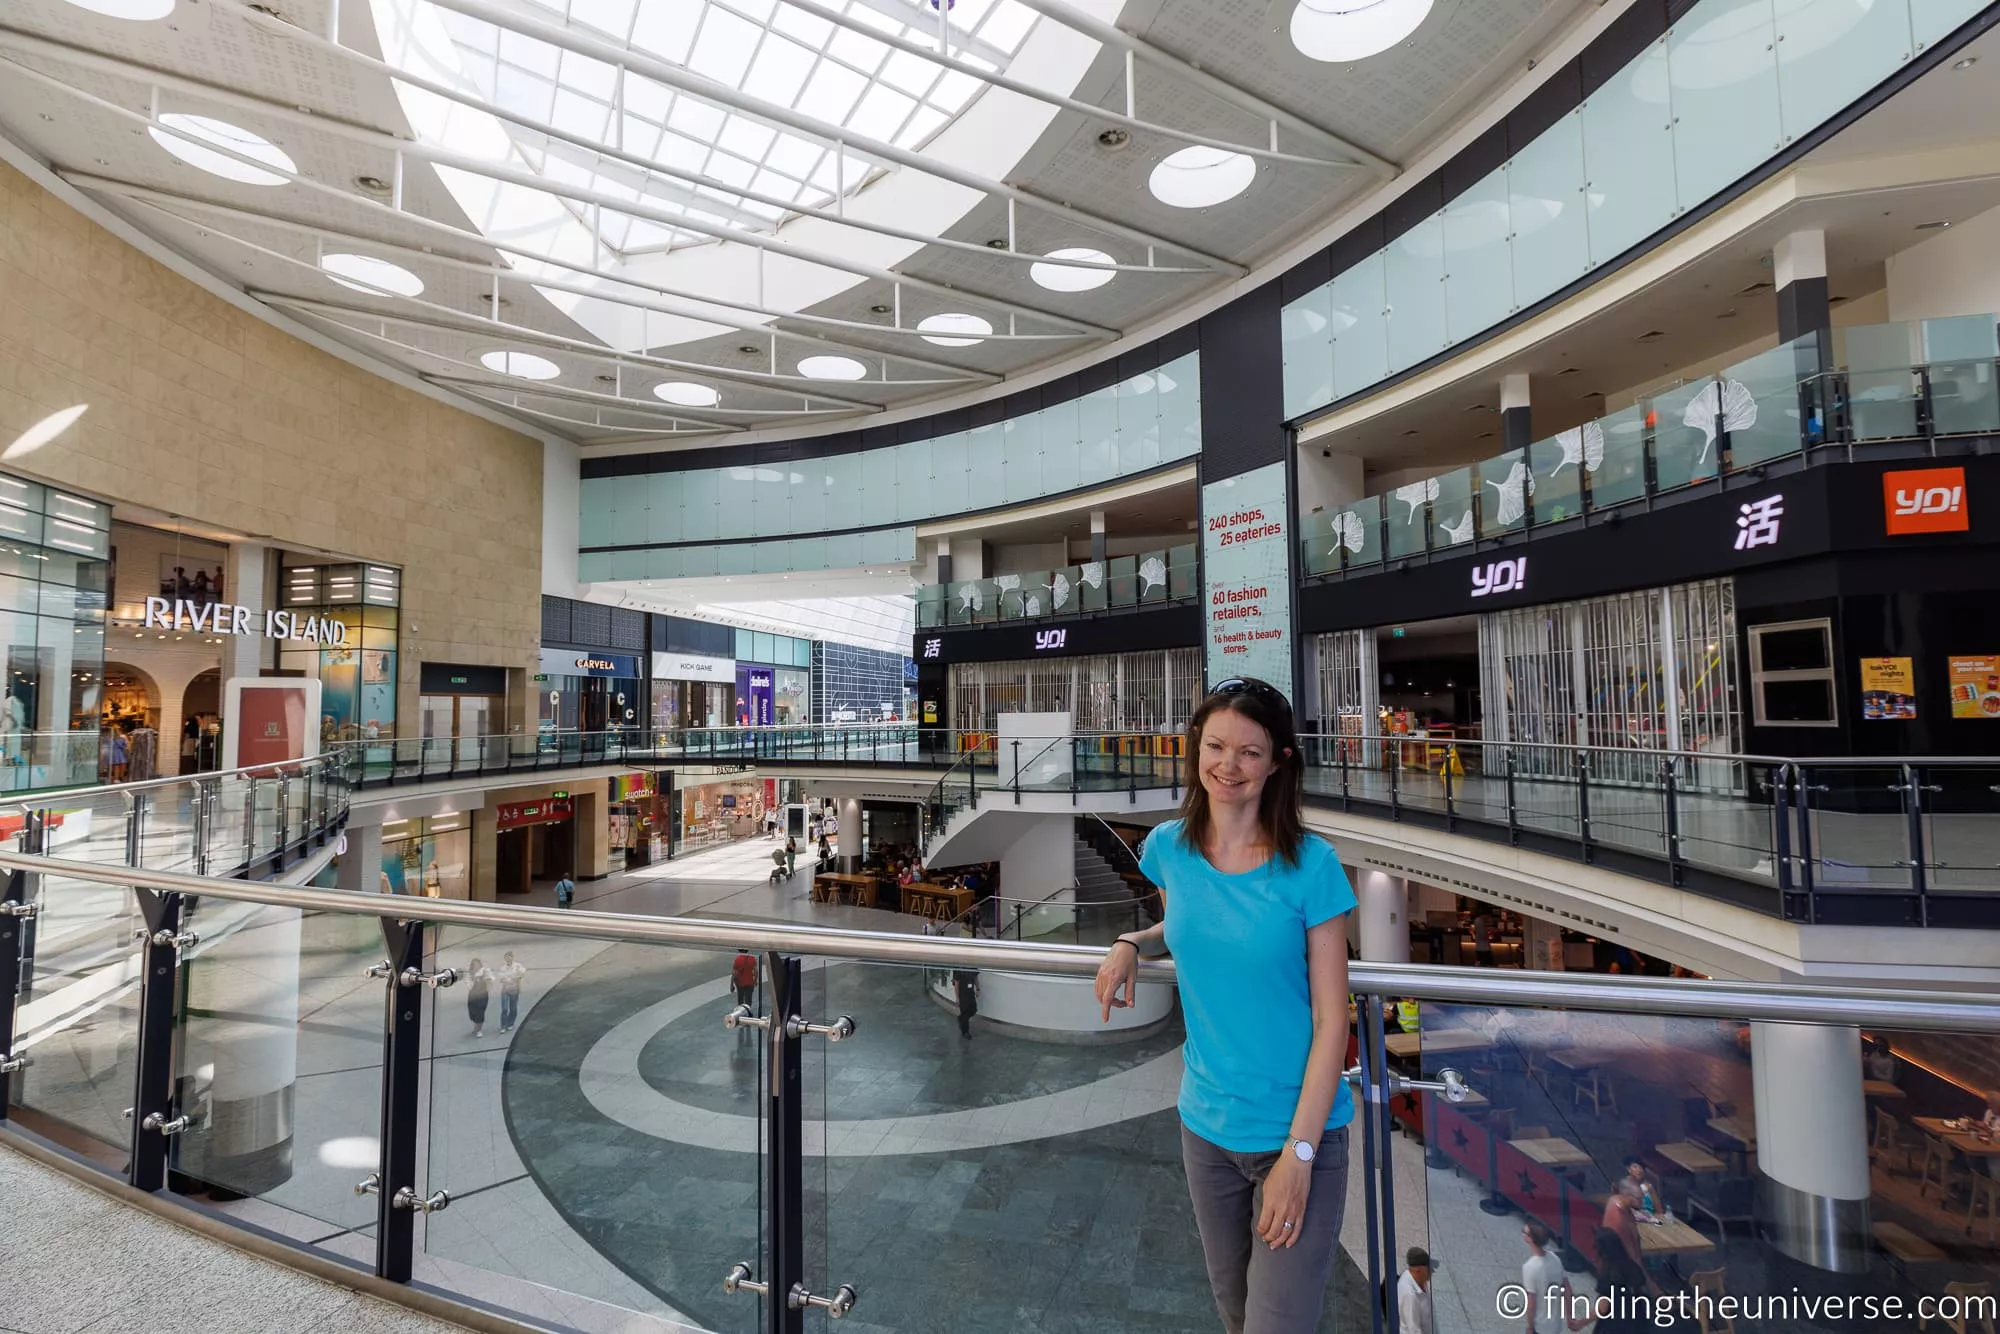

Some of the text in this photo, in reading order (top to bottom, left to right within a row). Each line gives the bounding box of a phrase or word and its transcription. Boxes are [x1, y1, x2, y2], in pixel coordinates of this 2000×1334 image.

[1894, 484, 1962, 516] YO!
[1209, 508, 1265, 531] 240 shops,
[1733, 493, 1784, 551] 活
[1220, 522, 1281, 546] 25 eateries
[1470, 555, 1526, 598] YO!
[1212, 585, 1267, 605] 60 fashion
[145, 596, 346, 646] RIVER ISLAND
[1213, 604, 1262, 621] retailers,
[1213, 624, 1224, 633] and
[1214, 628, 1282, 644] 16 health & beauty
[923, 638, 942, 658] 活
[1034, 628, 1067, 650] YO!
[576, 659, 615, 671] CARVELA
[680, 663, 713, 672] KICK GAME
[624, 789, 650, 800] swatch
